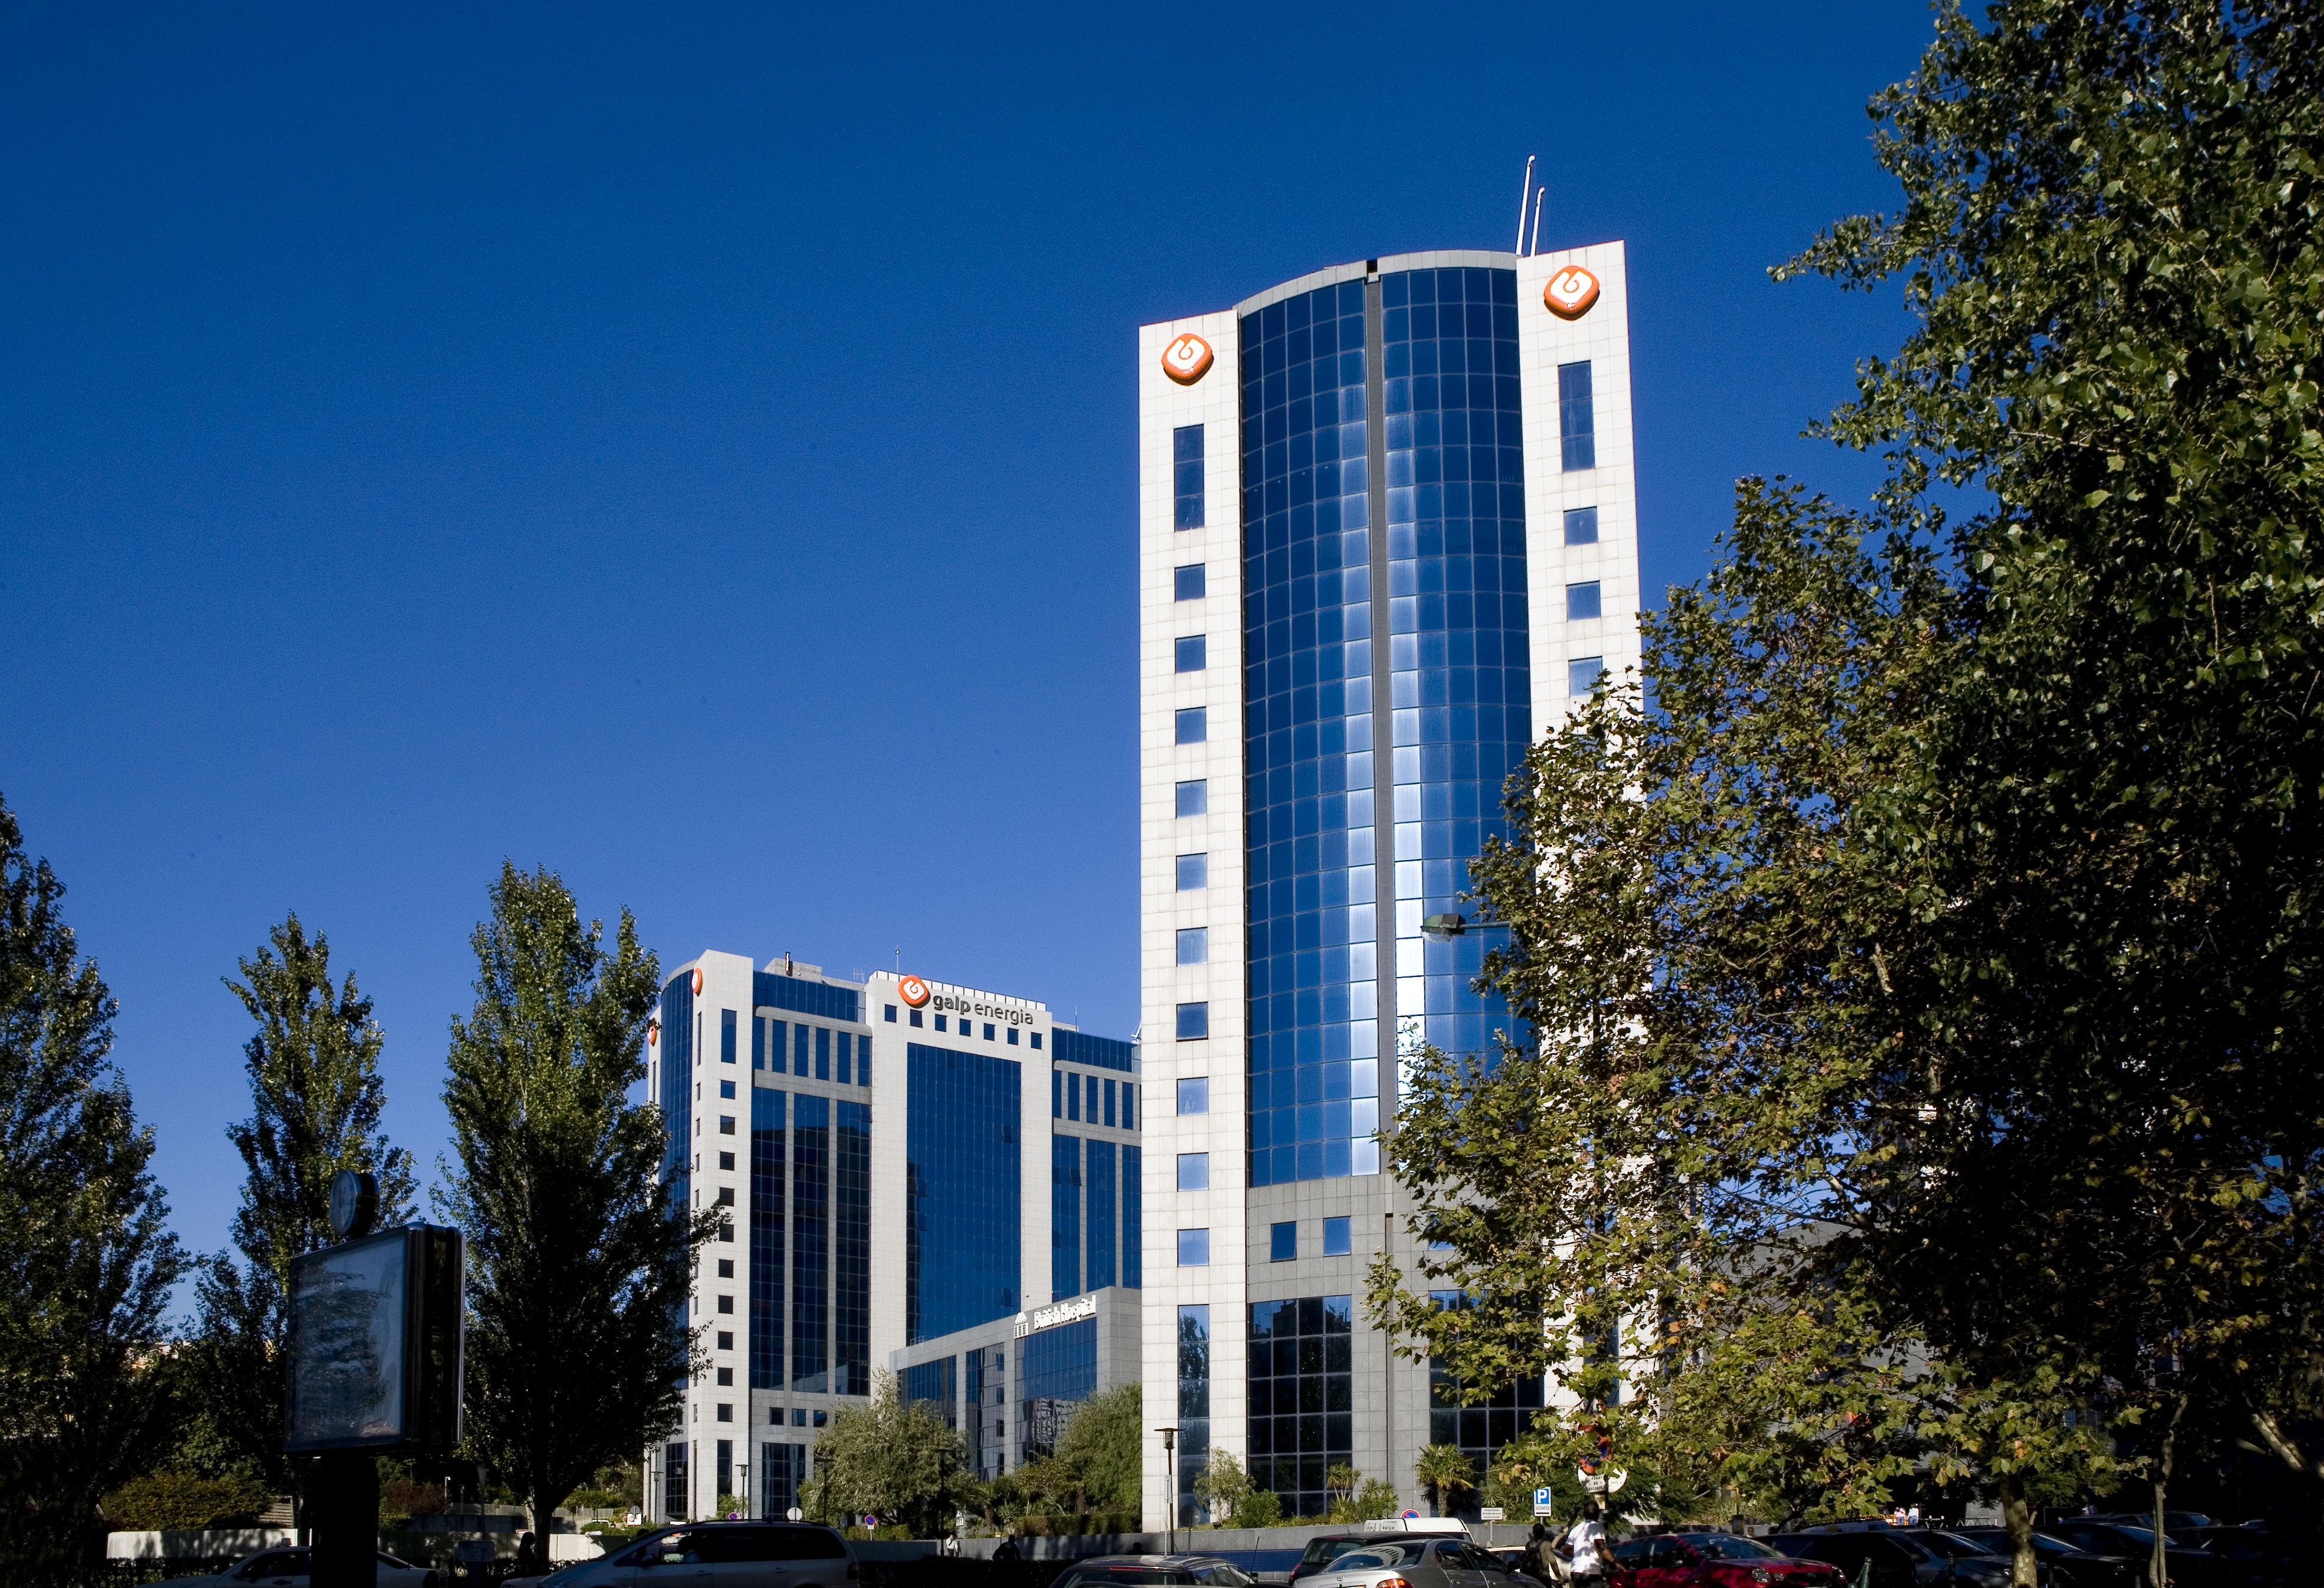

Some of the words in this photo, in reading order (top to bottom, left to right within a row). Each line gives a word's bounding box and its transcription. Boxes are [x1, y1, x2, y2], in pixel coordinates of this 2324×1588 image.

[933, 995, 971, 1015] galp
[974, 1003, 1033, 1025] energia
[1537, 1489, 1547, 1504] P
